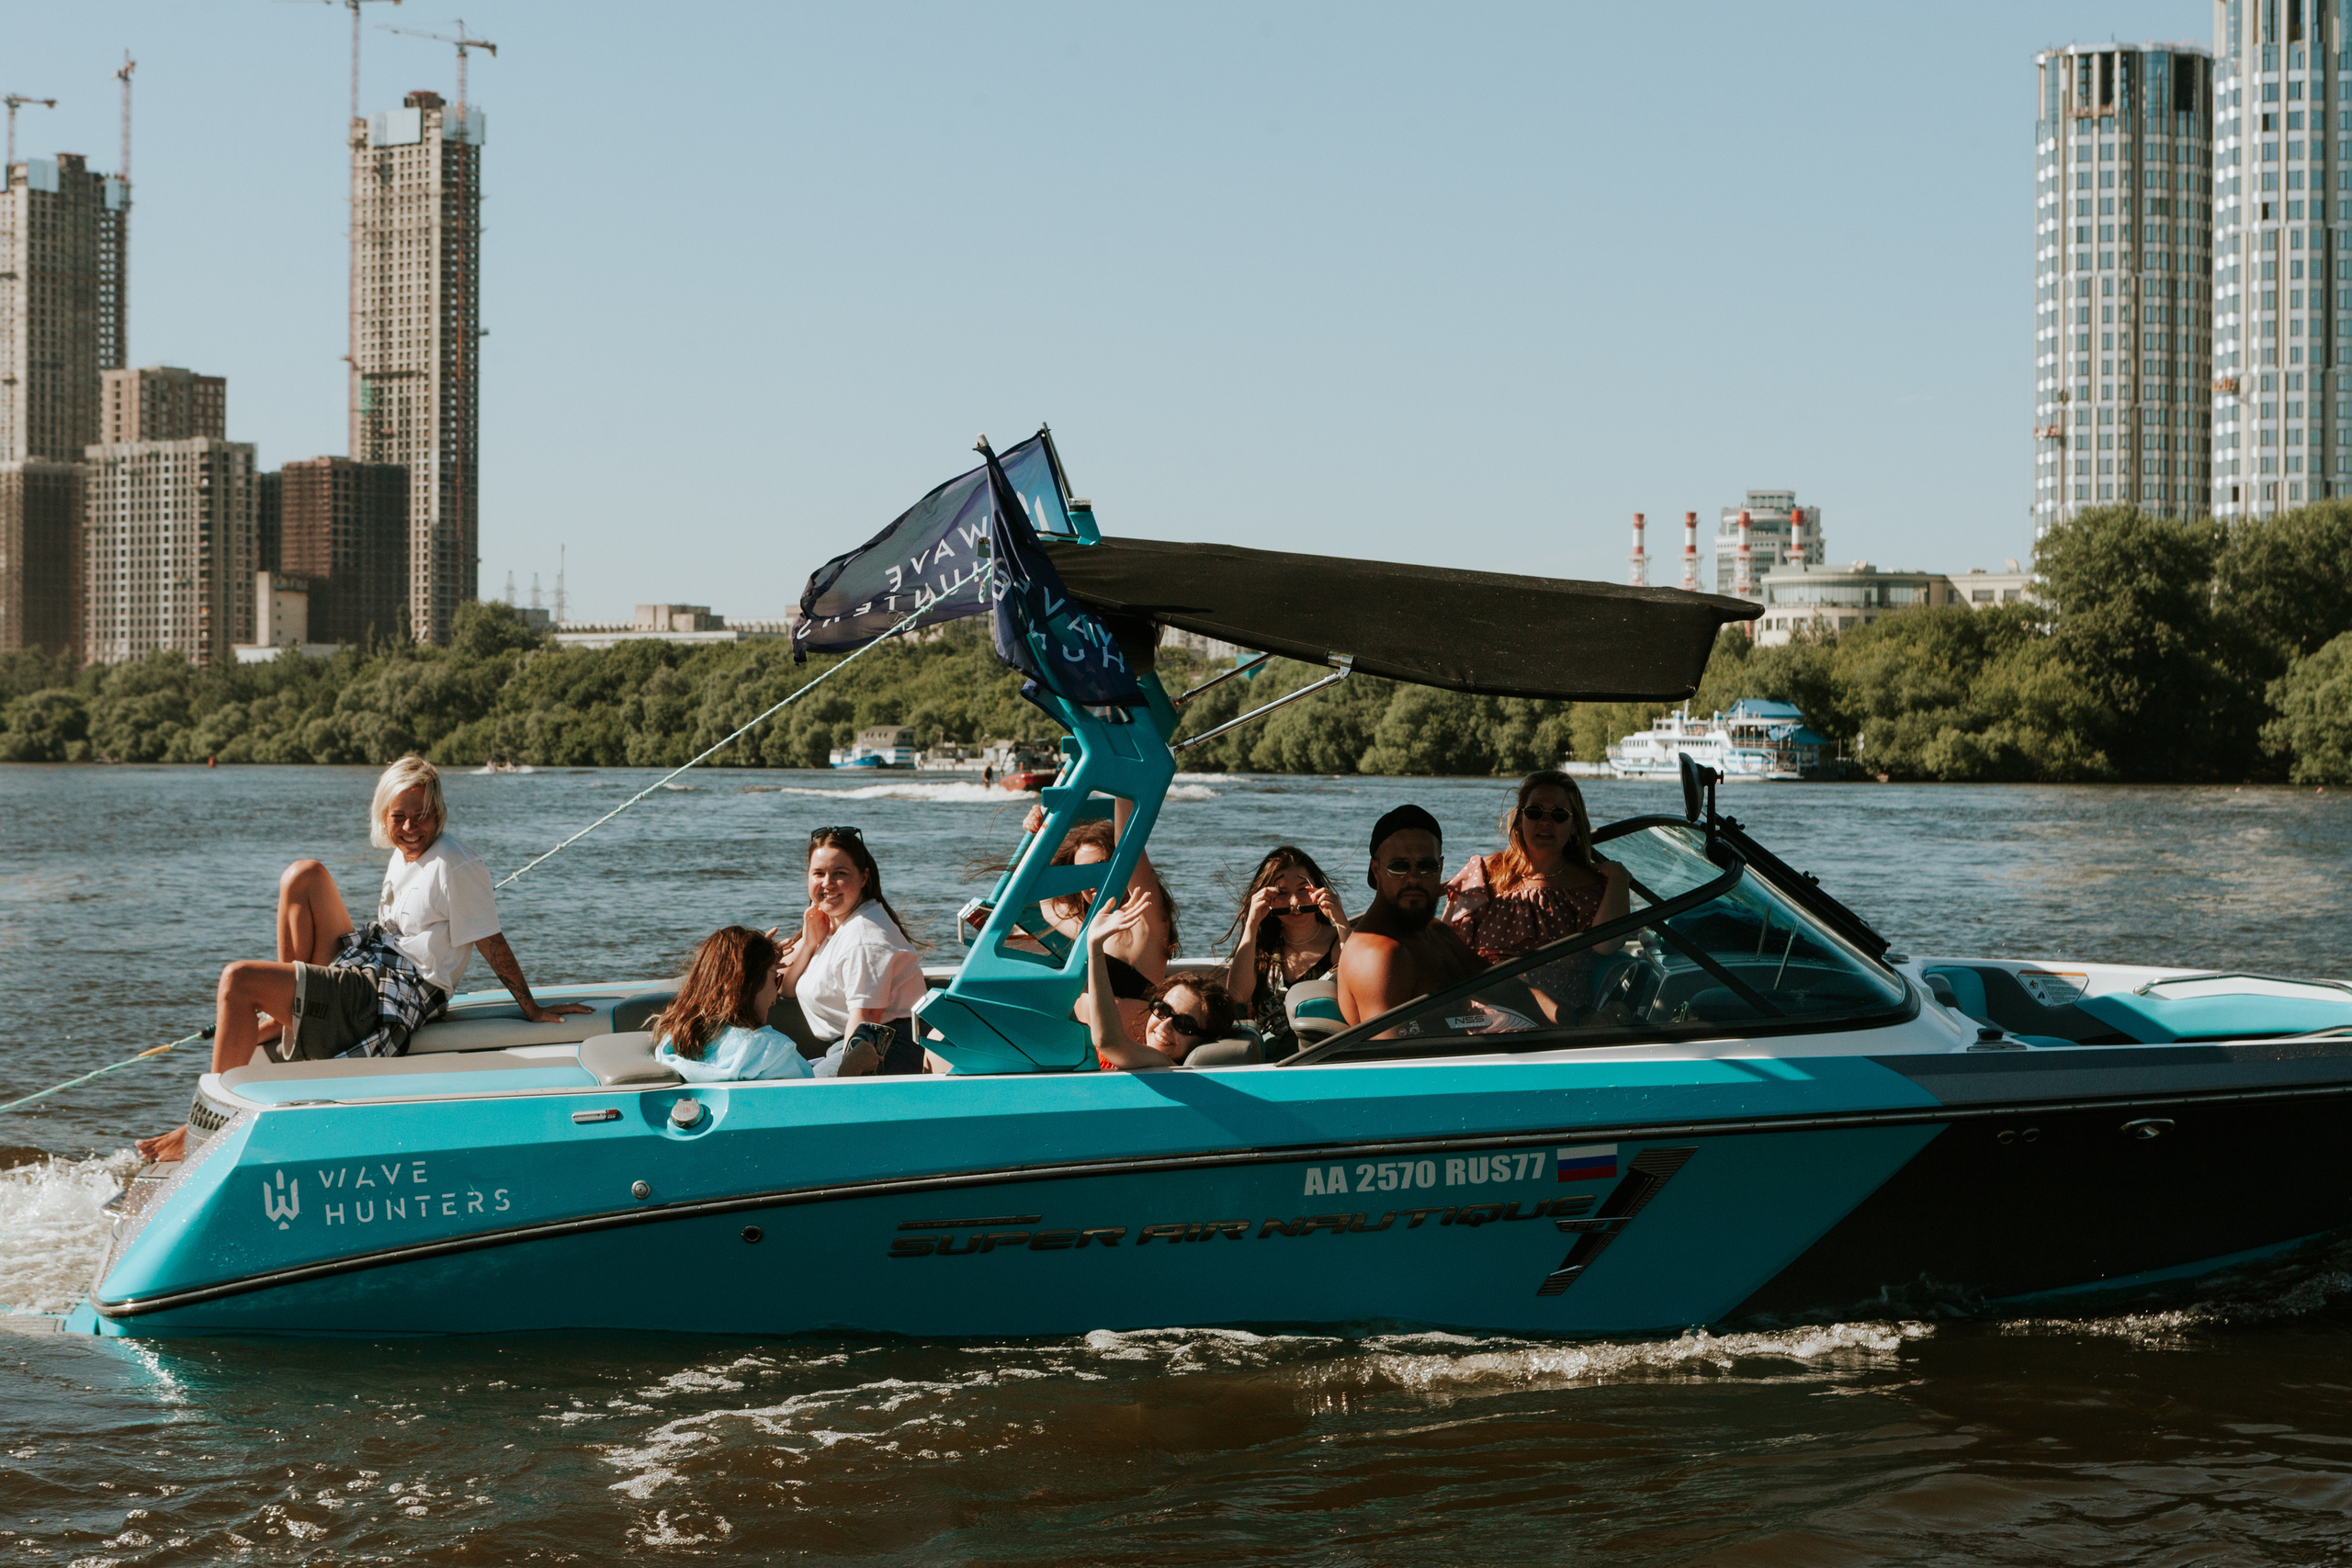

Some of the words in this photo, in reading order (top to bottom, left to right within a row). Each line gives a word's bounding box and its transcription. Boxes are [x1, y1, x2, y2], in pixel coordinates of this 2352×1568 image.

[1454, 1015, 1485, 1024] NSS
[318, 1160, 429, 1190] WAVE
[1303, 1167, 1350, 1197] AA
[1355, 1159, 1435, 1193] 2570
[1445, 1152, 1547, 1187] RUS77
[324, 1188, 511, 1226] HUNTERS
[888, 1226, 1127, 1258] SUPER
[1136, 1219, 1252, 1246] AIR
[1258, 1195, 1597, 1240] NAUTIQUE
